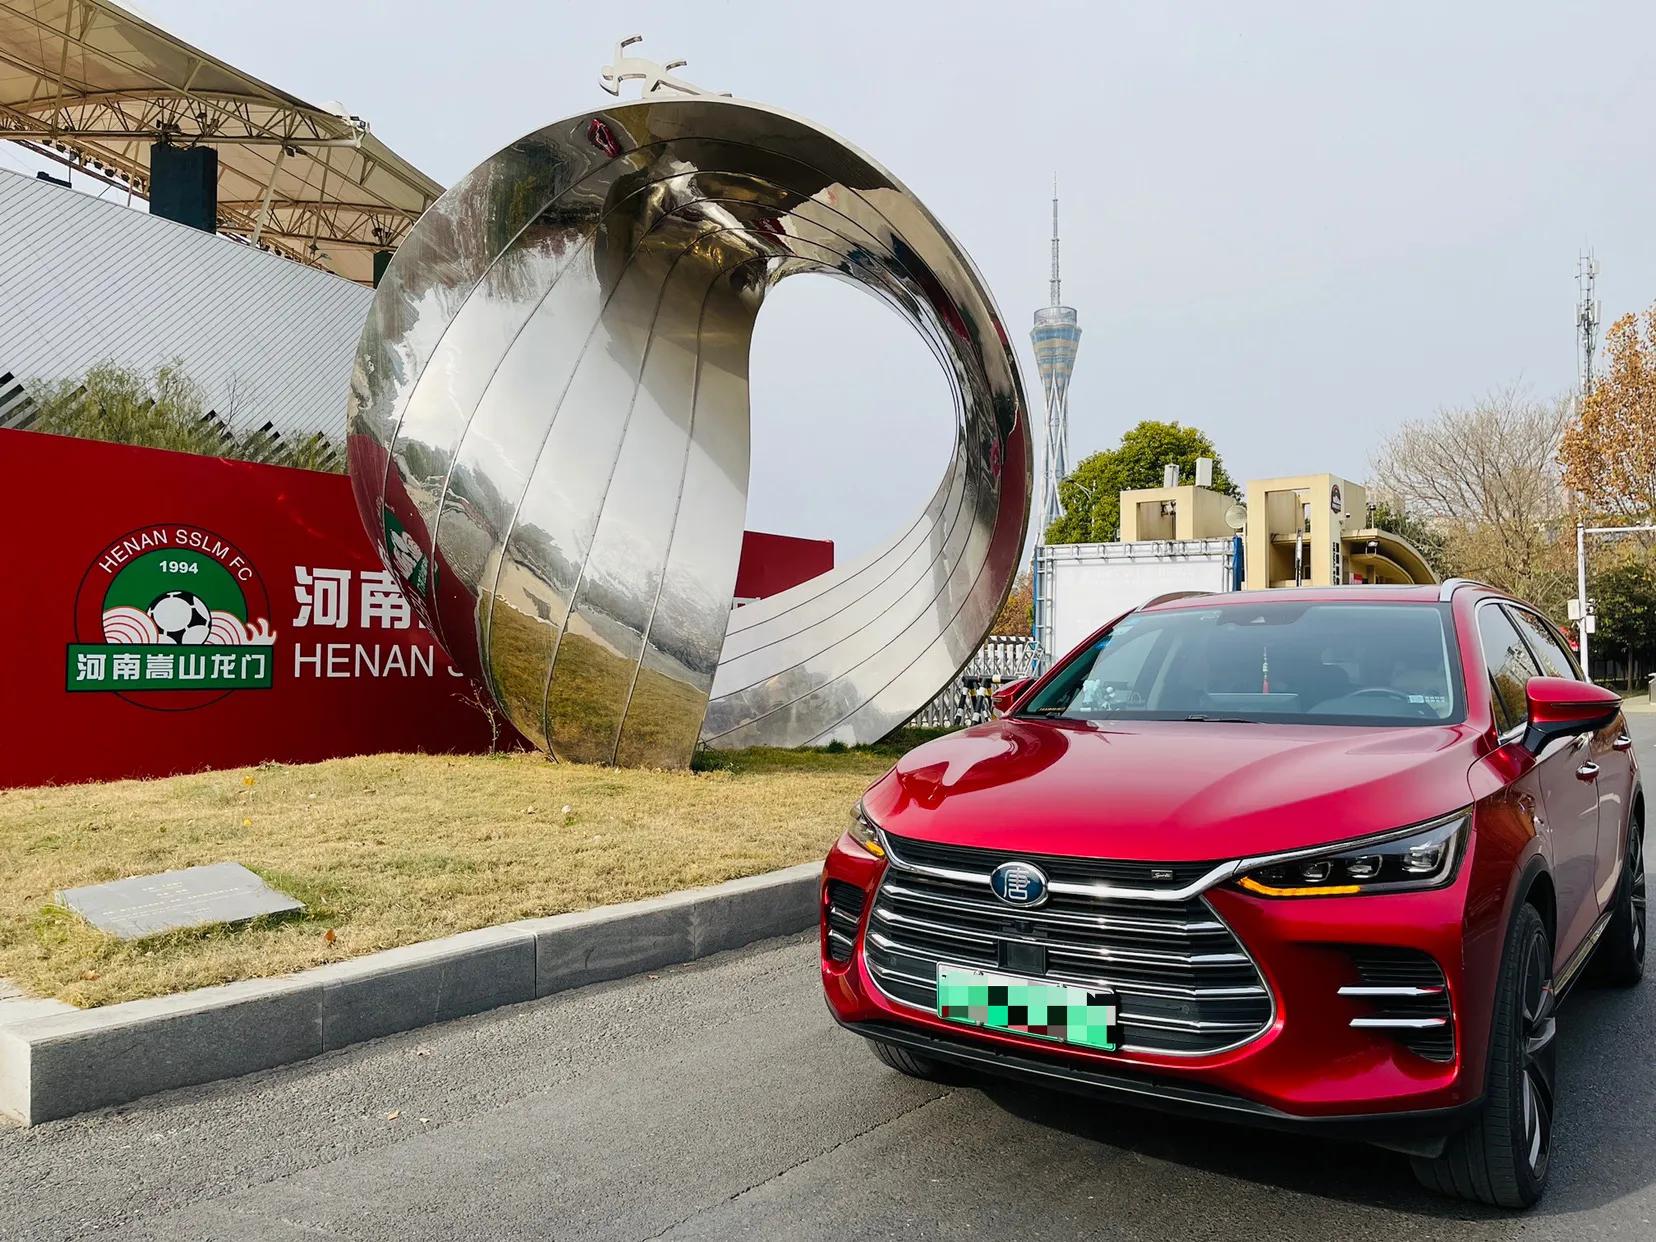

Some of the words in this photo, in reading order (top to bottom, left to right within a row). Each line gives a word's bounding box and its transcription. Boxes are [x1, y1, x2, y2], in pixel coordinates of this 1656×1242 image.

[99, 529, 168, 574] HENAN
[175, 529, 230, 560] SSLM
[229, 556, 253, 581] FC
[159, 560, 199, 575] 1994
[293, 565, 427, 629] 河南
[76, 653, 266, 681] 河南嵩山龙门
[294, 643, 434, 678] HENAN
